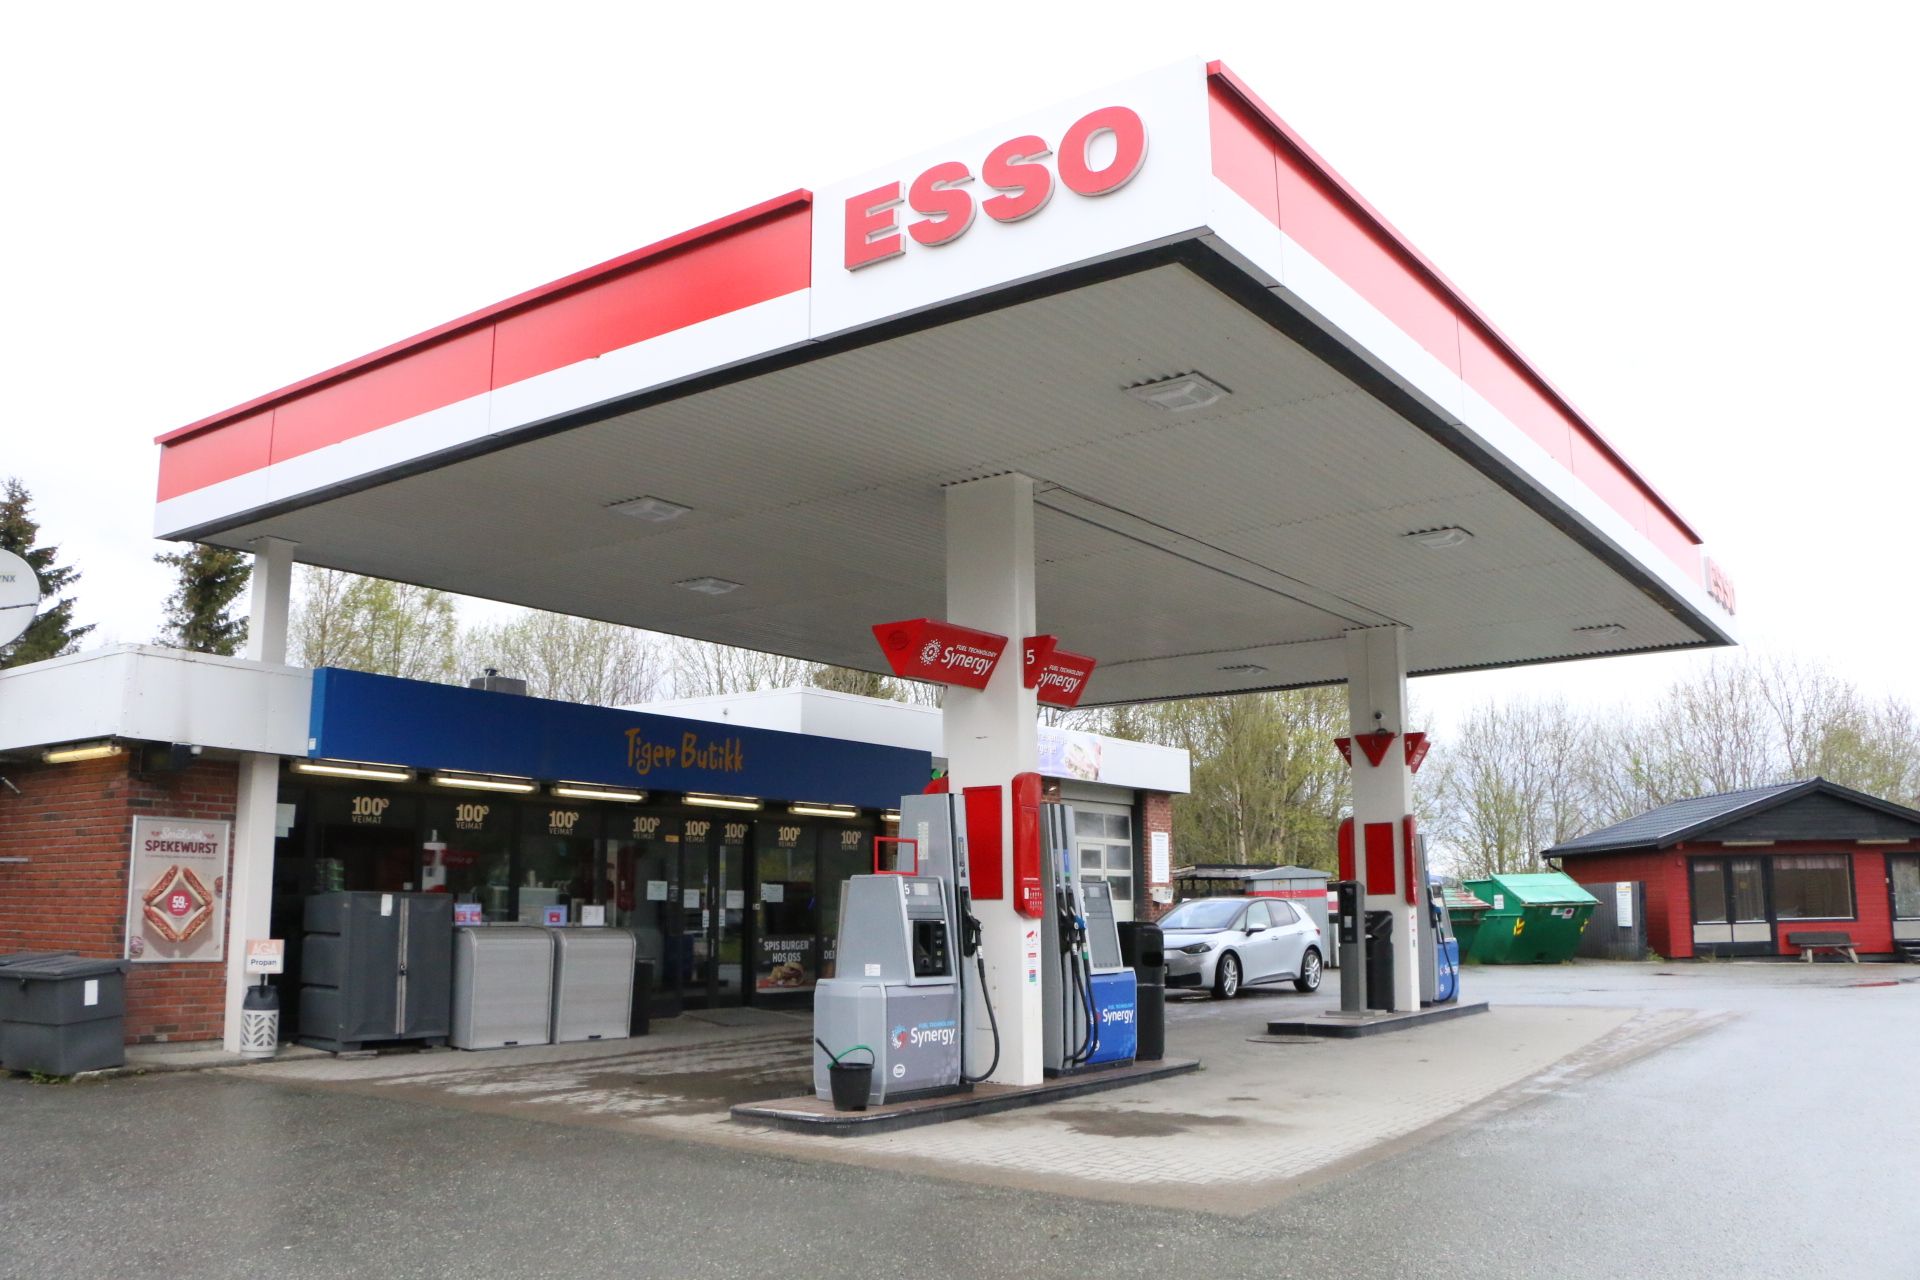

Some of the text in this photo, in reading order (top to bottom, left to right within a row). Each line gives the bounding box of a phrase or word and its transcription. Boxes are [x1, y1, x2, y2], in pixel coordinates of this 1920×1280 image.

[845, 106, 1149, 272] ESSO
[941, 647, 993, 676] Synergy
[1026, 649, 1035, 665] 5
[624, 727, 744, 775] Tiger Butikk
[1406, 741, 1412, 751] 1
[352, 815, 382, 824] VEIMAT
[456, 822, 483, 830] VEIMAT
[549, 827, 573, 836] VEIMAT
[145, 840, 218, 854] SPEKEWURST
[904, 884, 910, 895] 5
[764, 940, 809, 951] SPIS BURGER
[250, 959, 277, 967] Propan
[772, 952, 801, 963] HOS OSS
[1102, 1008, 1134, 1026] Synergy
[911, 1027, 956, 1048] Synergy
